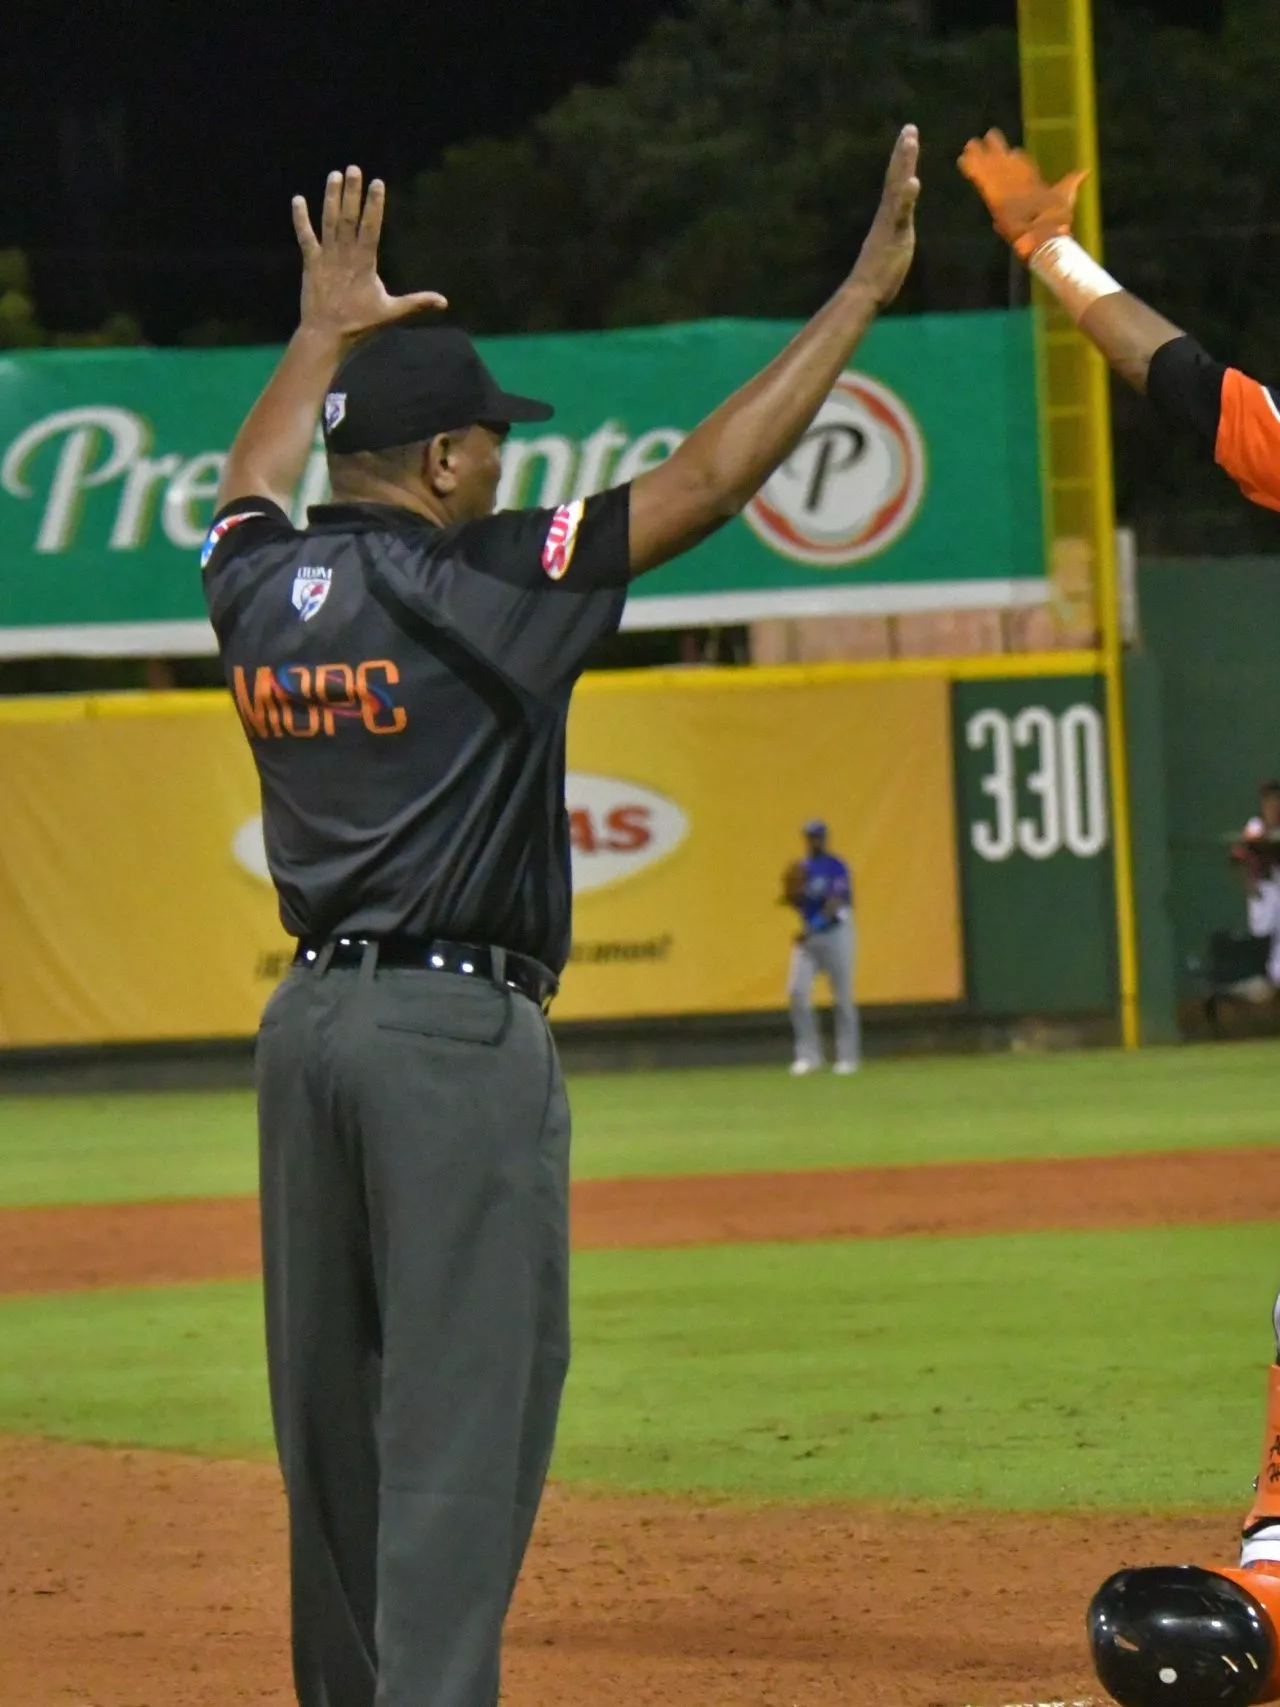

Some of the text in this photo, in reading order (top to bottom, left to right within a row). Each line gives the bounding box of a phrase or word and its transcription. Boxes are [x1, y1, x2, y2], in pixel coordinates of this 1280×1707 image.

[780, 421, 867, 513] P
[233, 659, 408, 740] MOPC
[966, 704, 1107, 862] 330
